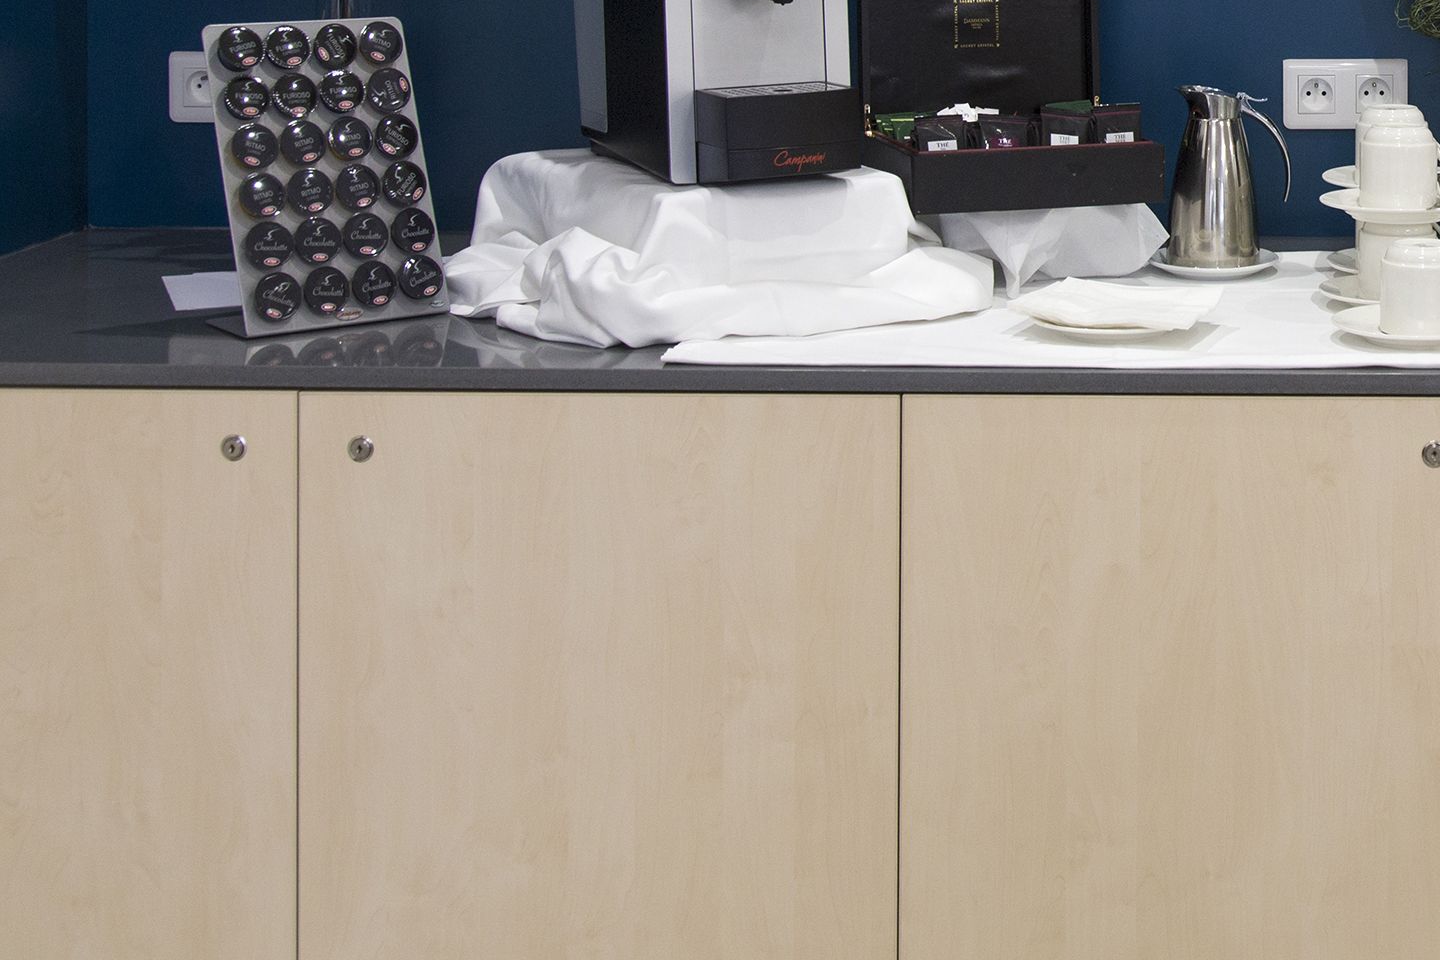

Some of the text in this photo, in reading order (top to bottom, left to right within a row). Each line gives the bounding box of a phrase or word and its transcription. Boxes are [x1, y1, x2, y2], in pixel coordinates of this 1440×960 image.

[384, 126, 409, 146] FURIOSO
[245, 140, 266, 152] RITMO
[294, 137, 314, 147] RITMO
[349, 183, 369, 192] RITMO
[397, 172, 416, 195] FURIOSO
[253, 190, 273, 200] RITMO
[300, 186, 321, 197] RITMO
